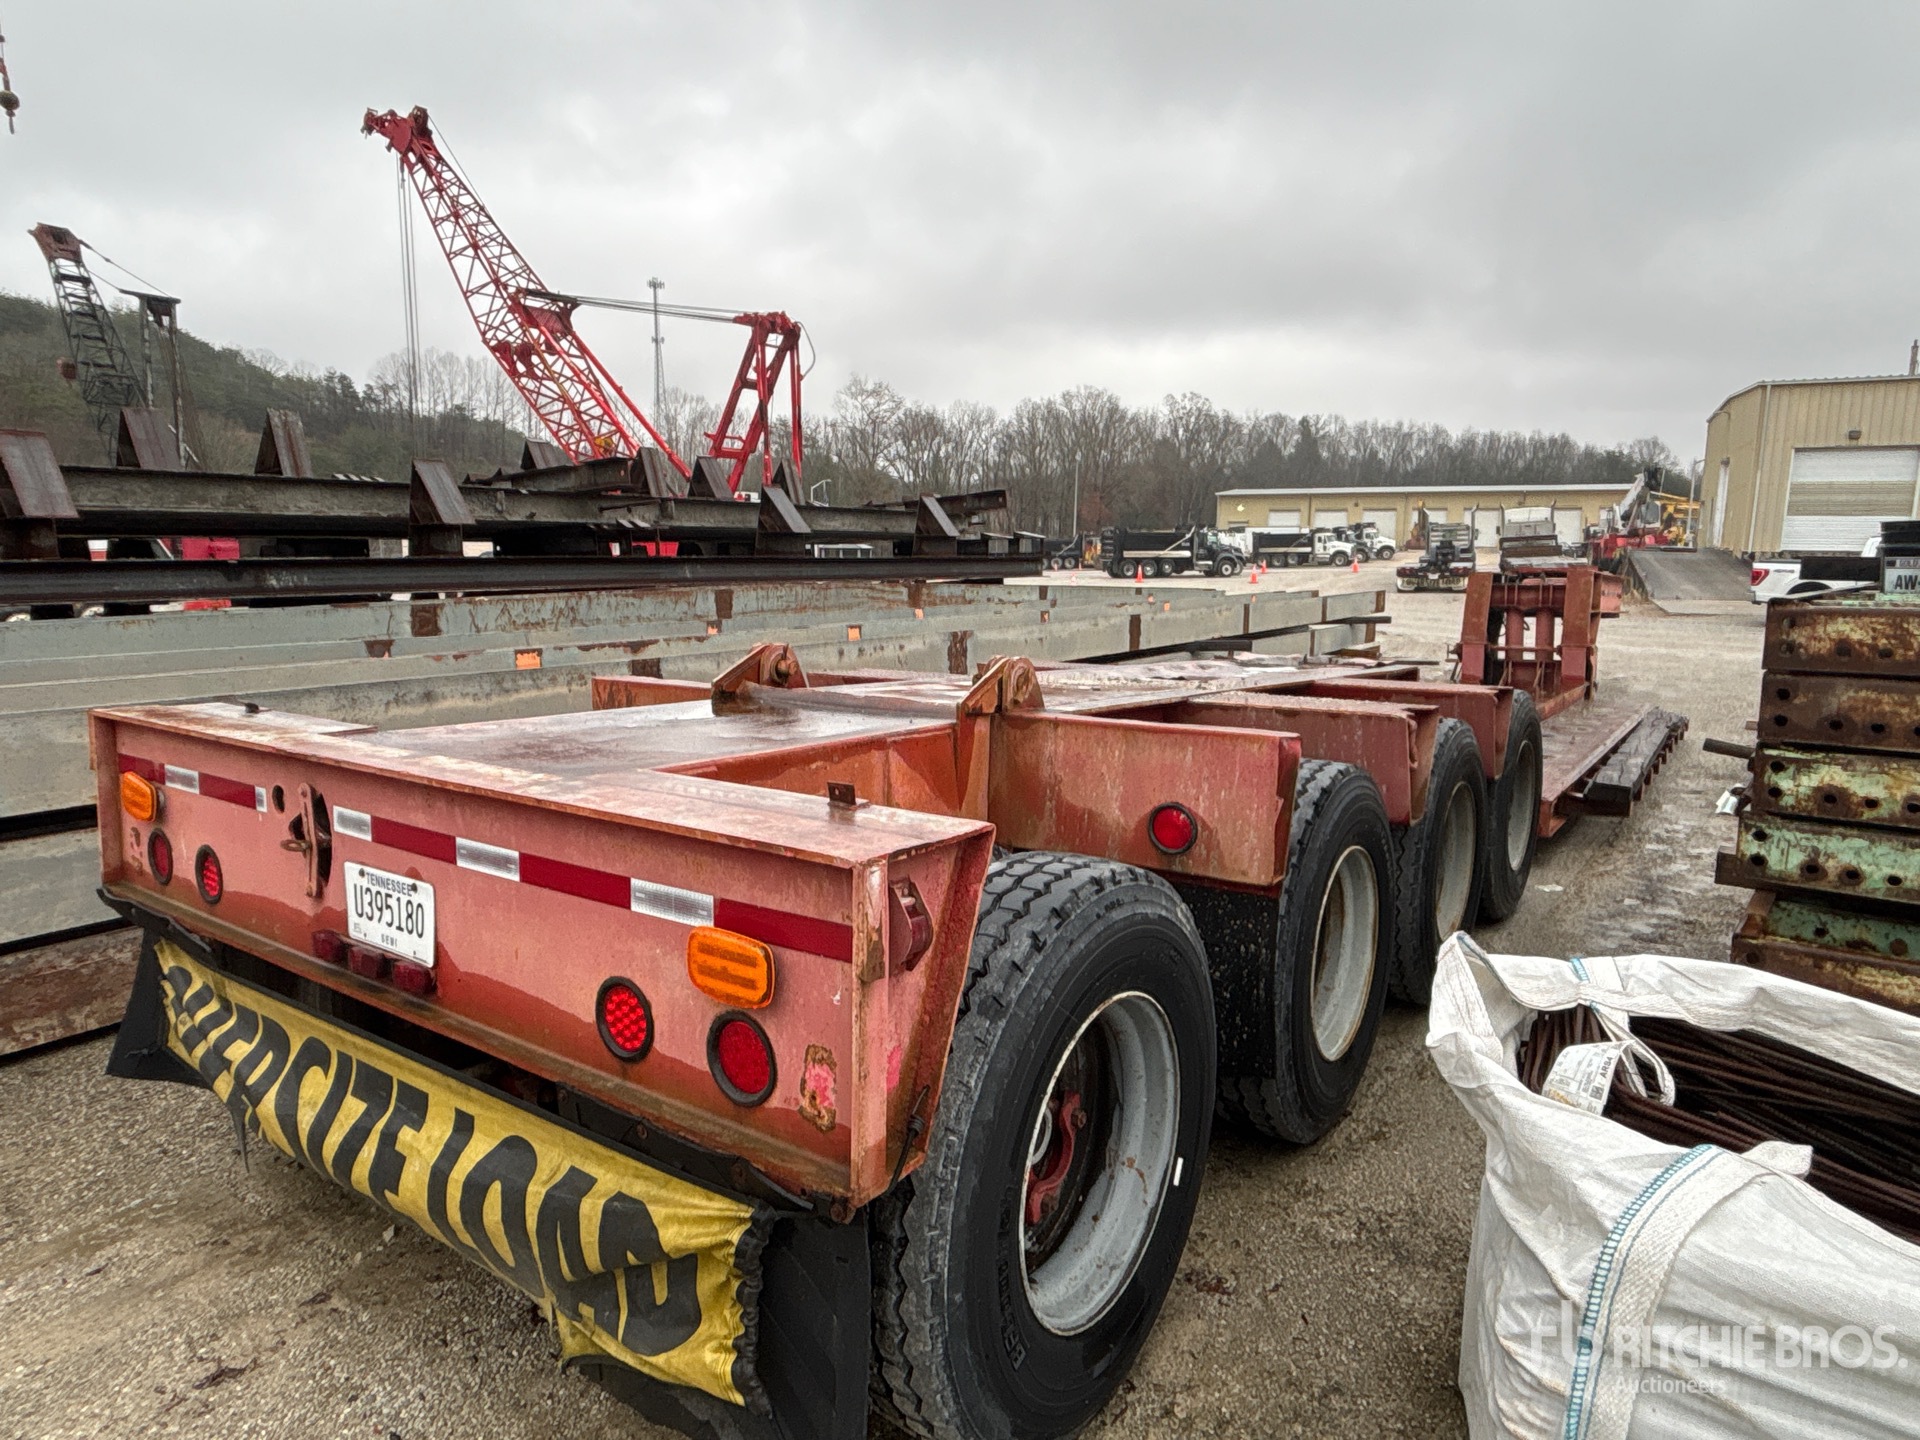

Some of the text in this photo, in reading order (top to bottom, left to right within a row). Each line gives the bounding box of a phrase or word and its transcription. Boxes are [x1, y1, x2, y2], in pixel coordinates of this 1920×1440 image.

[354, 883, 424, 938] U395180
[366, 872, 412, 897] TENNESSEE
[428, 1106, 702, 1356] LOAD
